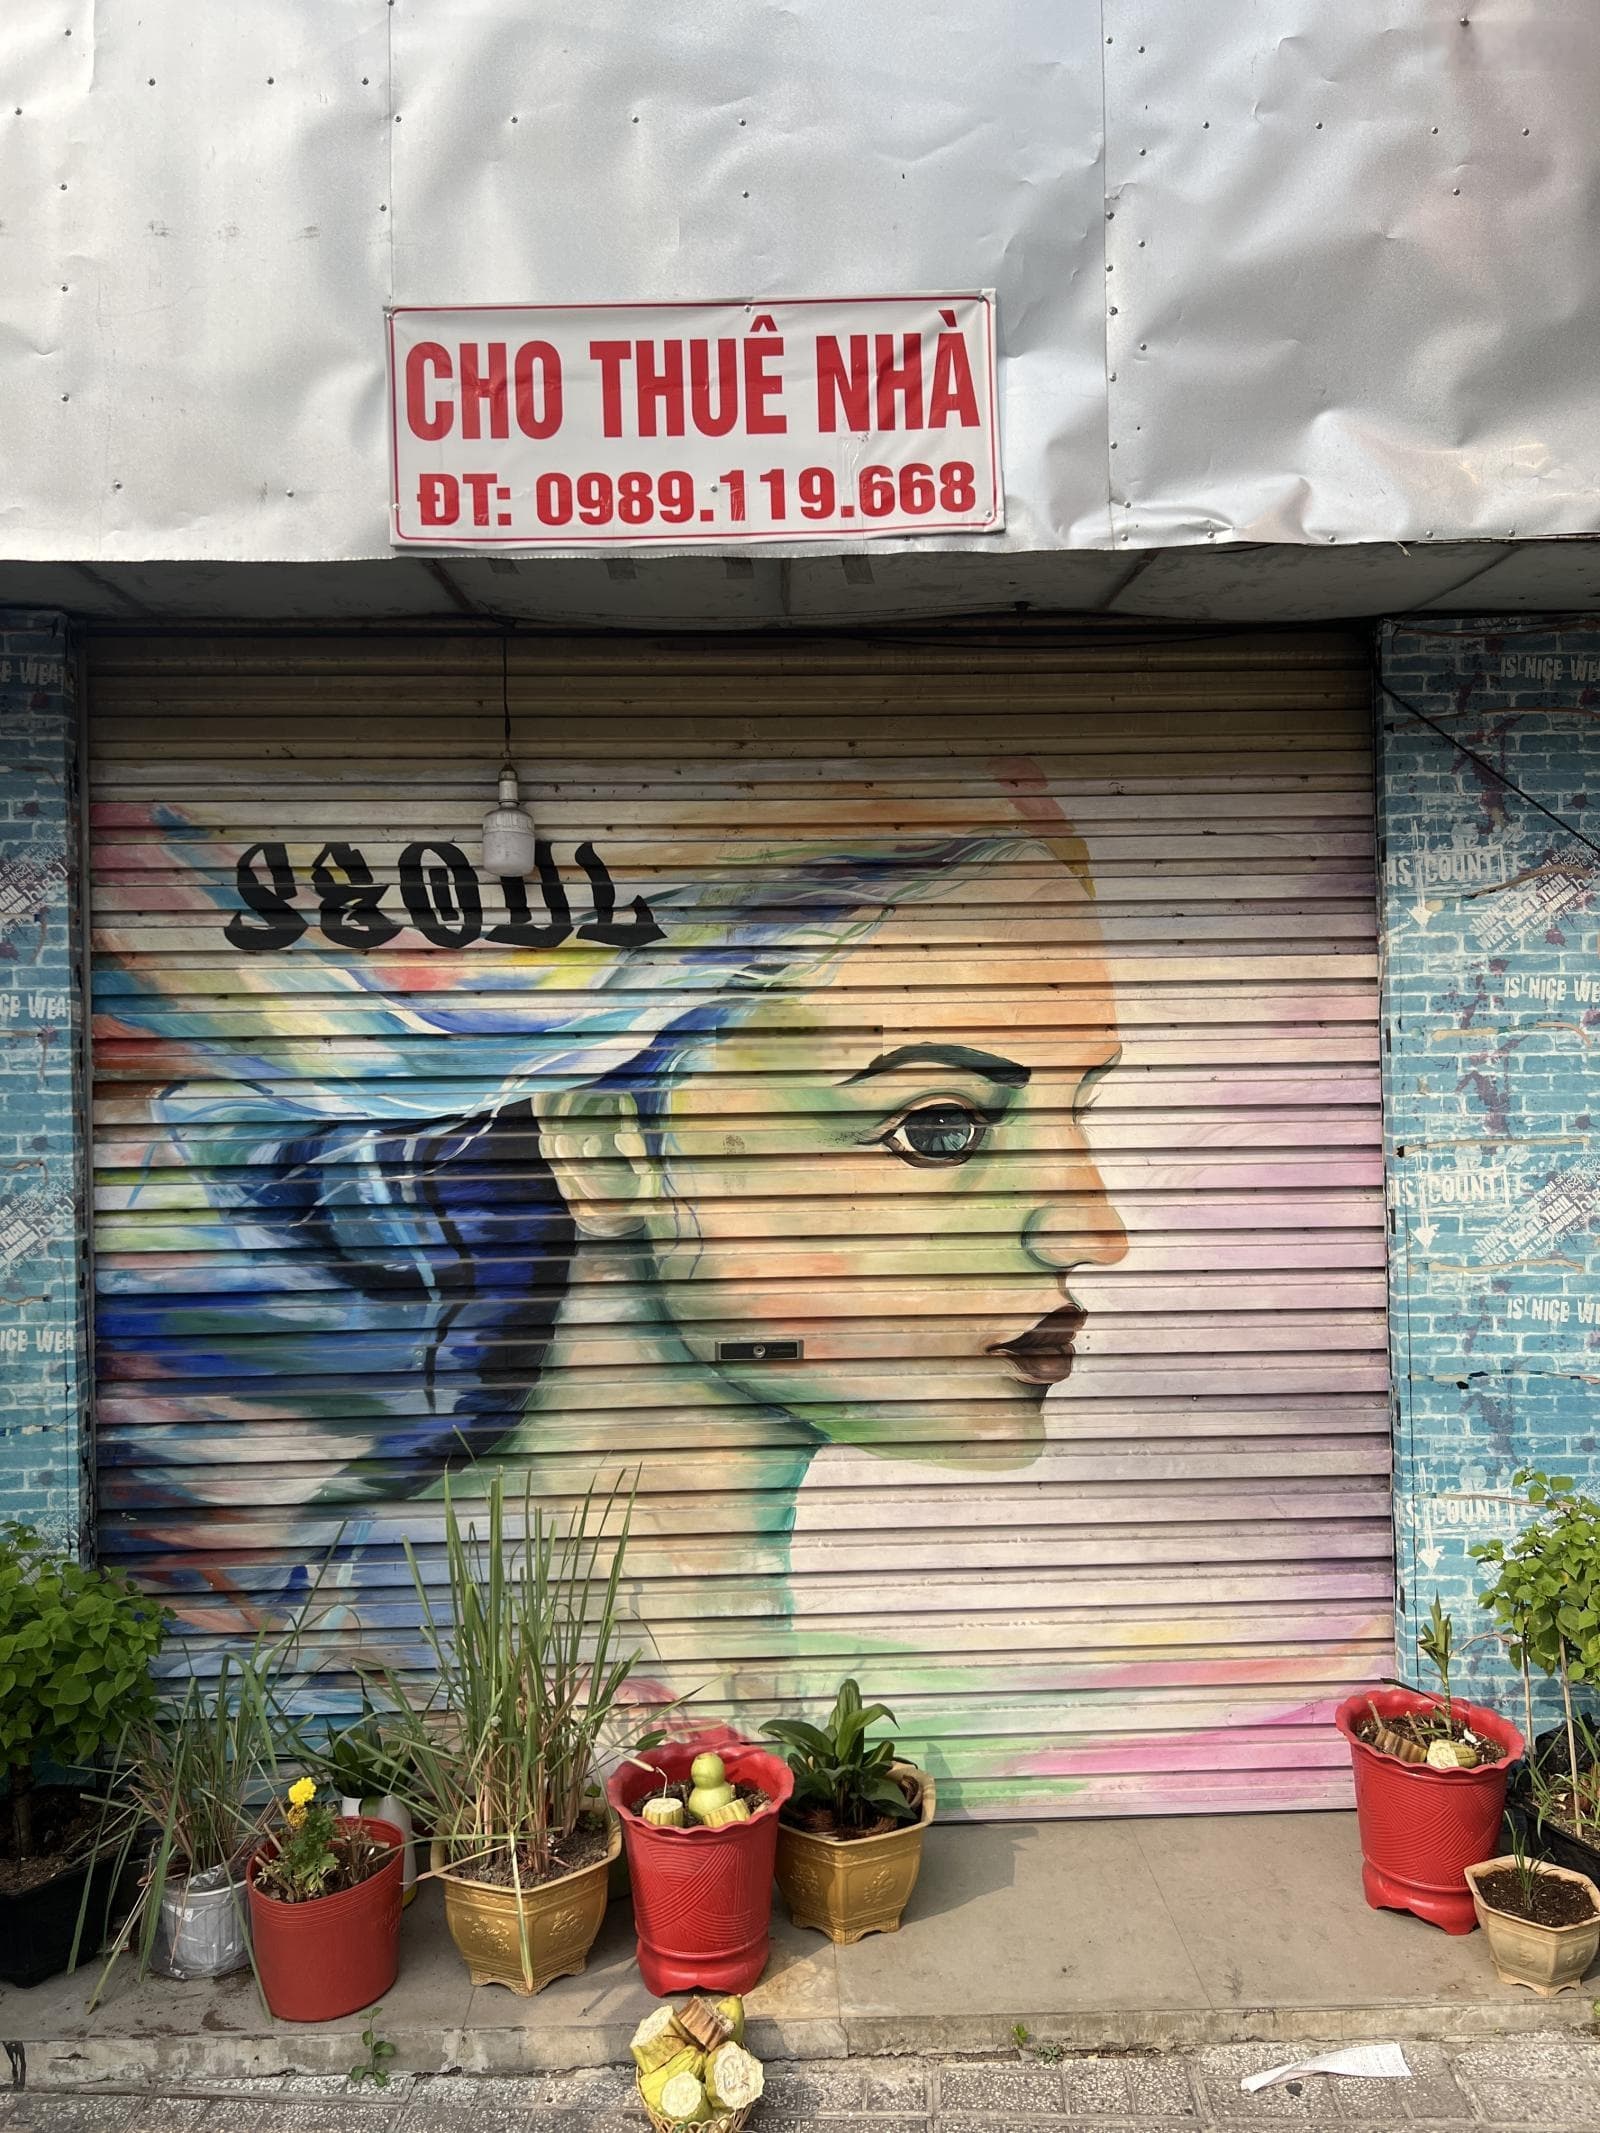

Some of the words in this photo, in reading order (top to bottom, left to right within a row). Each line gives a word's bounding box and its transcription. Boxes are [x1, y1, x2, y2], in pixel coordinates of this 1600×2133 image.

[406, 340, 563, 440] CHO
[589, 315, 788, 437] THUÊ
[816, 309, 980, 433] NHÀ
[417, 473, 511, 526] ĐT:
[537, 461, 976, 526] 0989.119.668
[1525, 656, 1563, 681] NICE
[1504, 976, 1520, 998] IS
[1529, 977, 1566, 1001] NICE
[1507, 1299, 1523, 1320] IS
[1532, 1299, 1569, 1323] NICE
